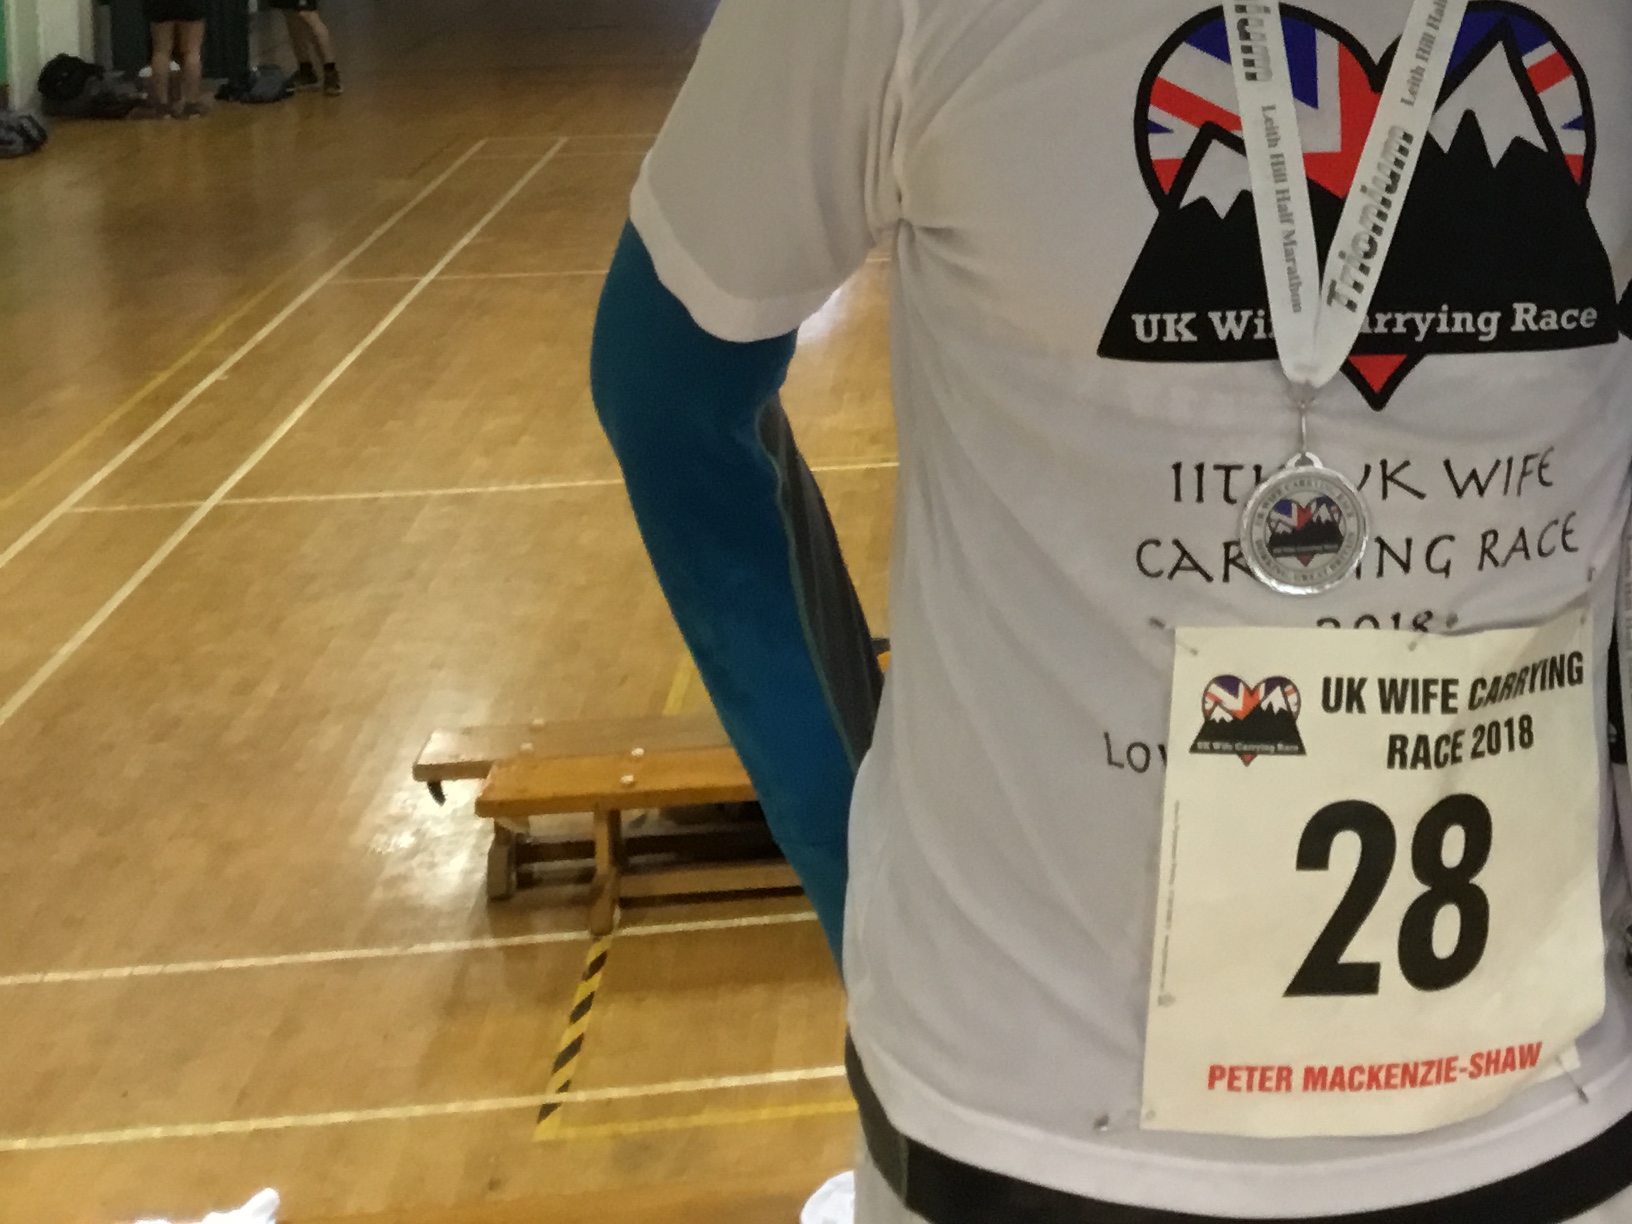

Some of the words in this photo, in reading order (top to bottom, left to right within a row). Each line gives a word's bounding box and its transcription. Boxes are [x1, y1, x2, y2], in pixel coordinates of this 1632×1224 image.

[1400, 64, 1426, 107] Leith
[1415, 32, 1437, 64] Hill
[1260, 104, 1281, 149] Leith
[1269, 152, 1289, 184] Hill
[1274, 187, 1295, 225] Half
[1326, 124, 1415, 314] Trionium
[1281, 229, 1303, 315] Marathon
[1131, 311, 1198, 343] UK
[1207, 308, 1275, 342] Wi
[1360, 303, 1502, 343] rrying
[1510, 301, 1598, 332] Race
[1443, 446, 1556, 501] WIFE
[1477, 510, 1581, 572] RACE
[1320, 677, 1369, 716] UK
[1378, 677, 1461, 716] WIFE
[1466, 650, 1585, 712] CARRYING
[1385, 728, 1466, 771] RACE
[1470, 714, 1536, 761] 2018
[1281, 792, 1494, 999] 28
[1206, 1063, 1295, 1095] PETER
[1301, 1040, 1545, 1094] MACKENZIE-SHAW
